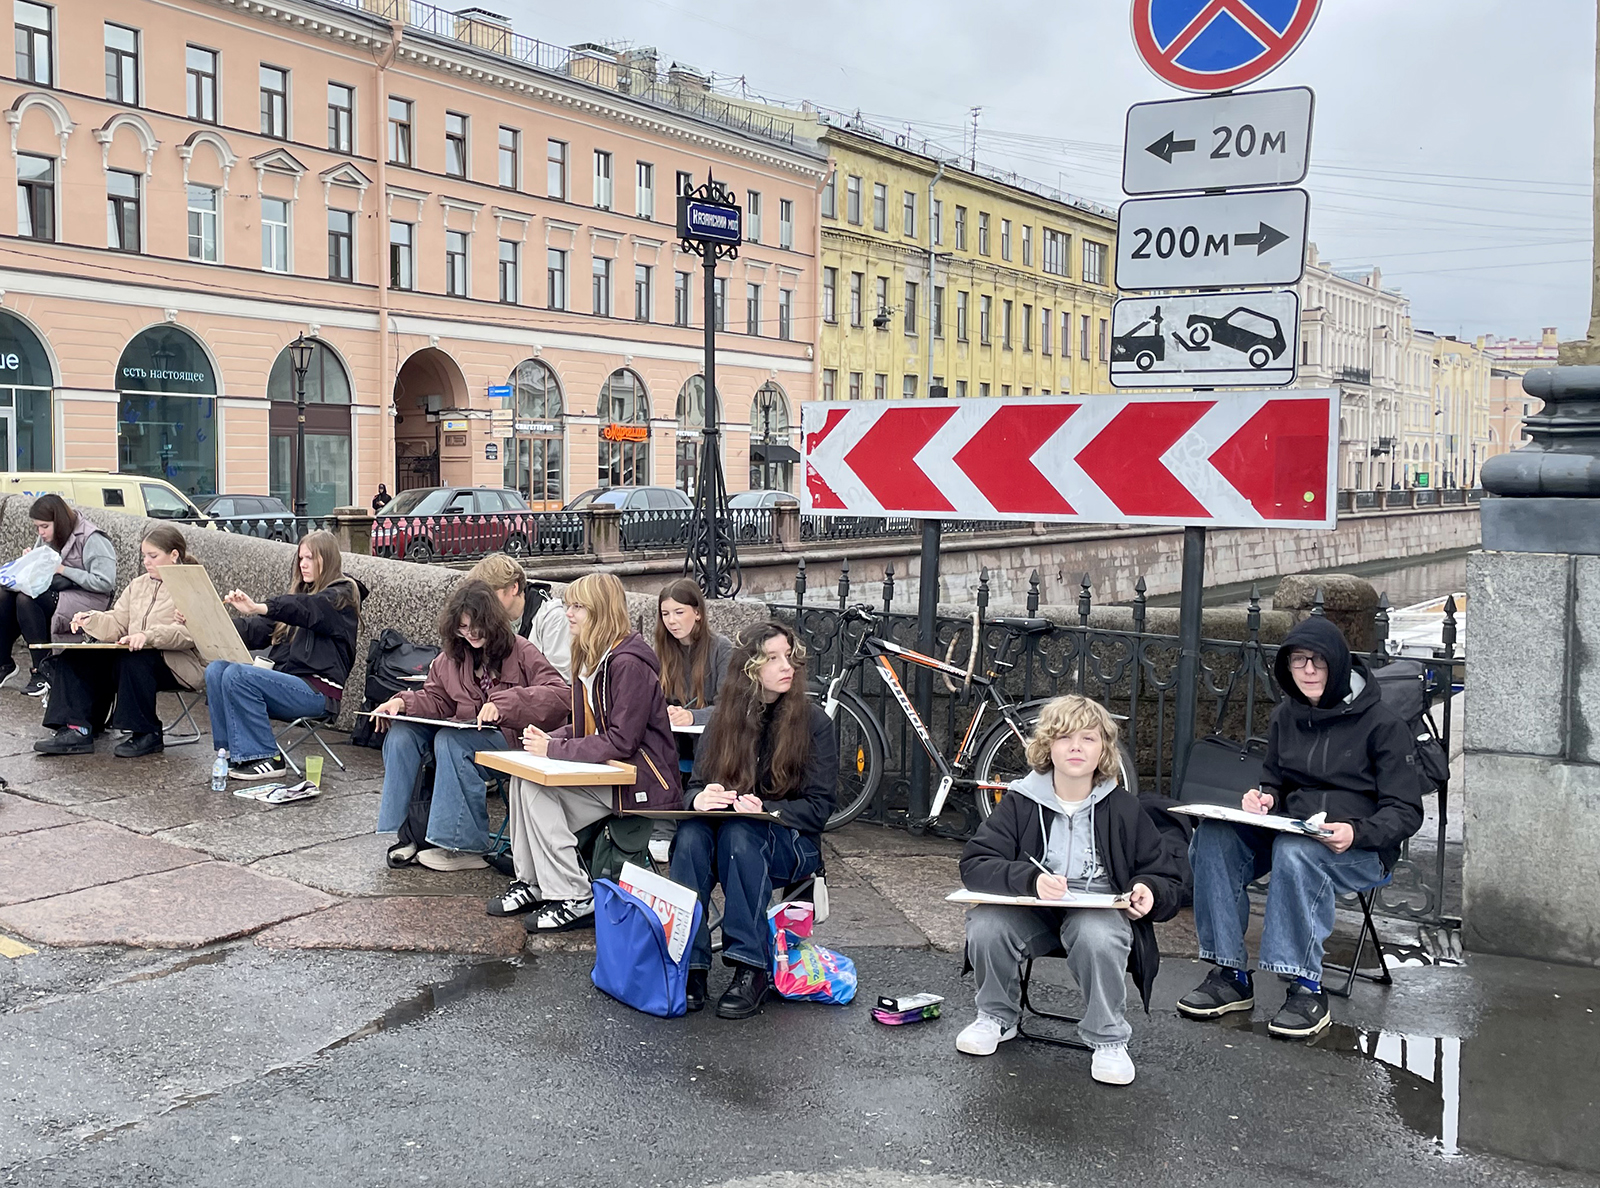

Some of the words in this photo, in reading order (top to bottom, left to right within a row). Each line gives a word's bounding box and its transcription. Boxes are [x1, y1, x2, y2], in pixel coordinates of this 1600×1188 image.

[123, 367, 146, 378] есть
[150, 368, 204, 382] настоящее
[880, 667, 930, 741] AUTHOR
